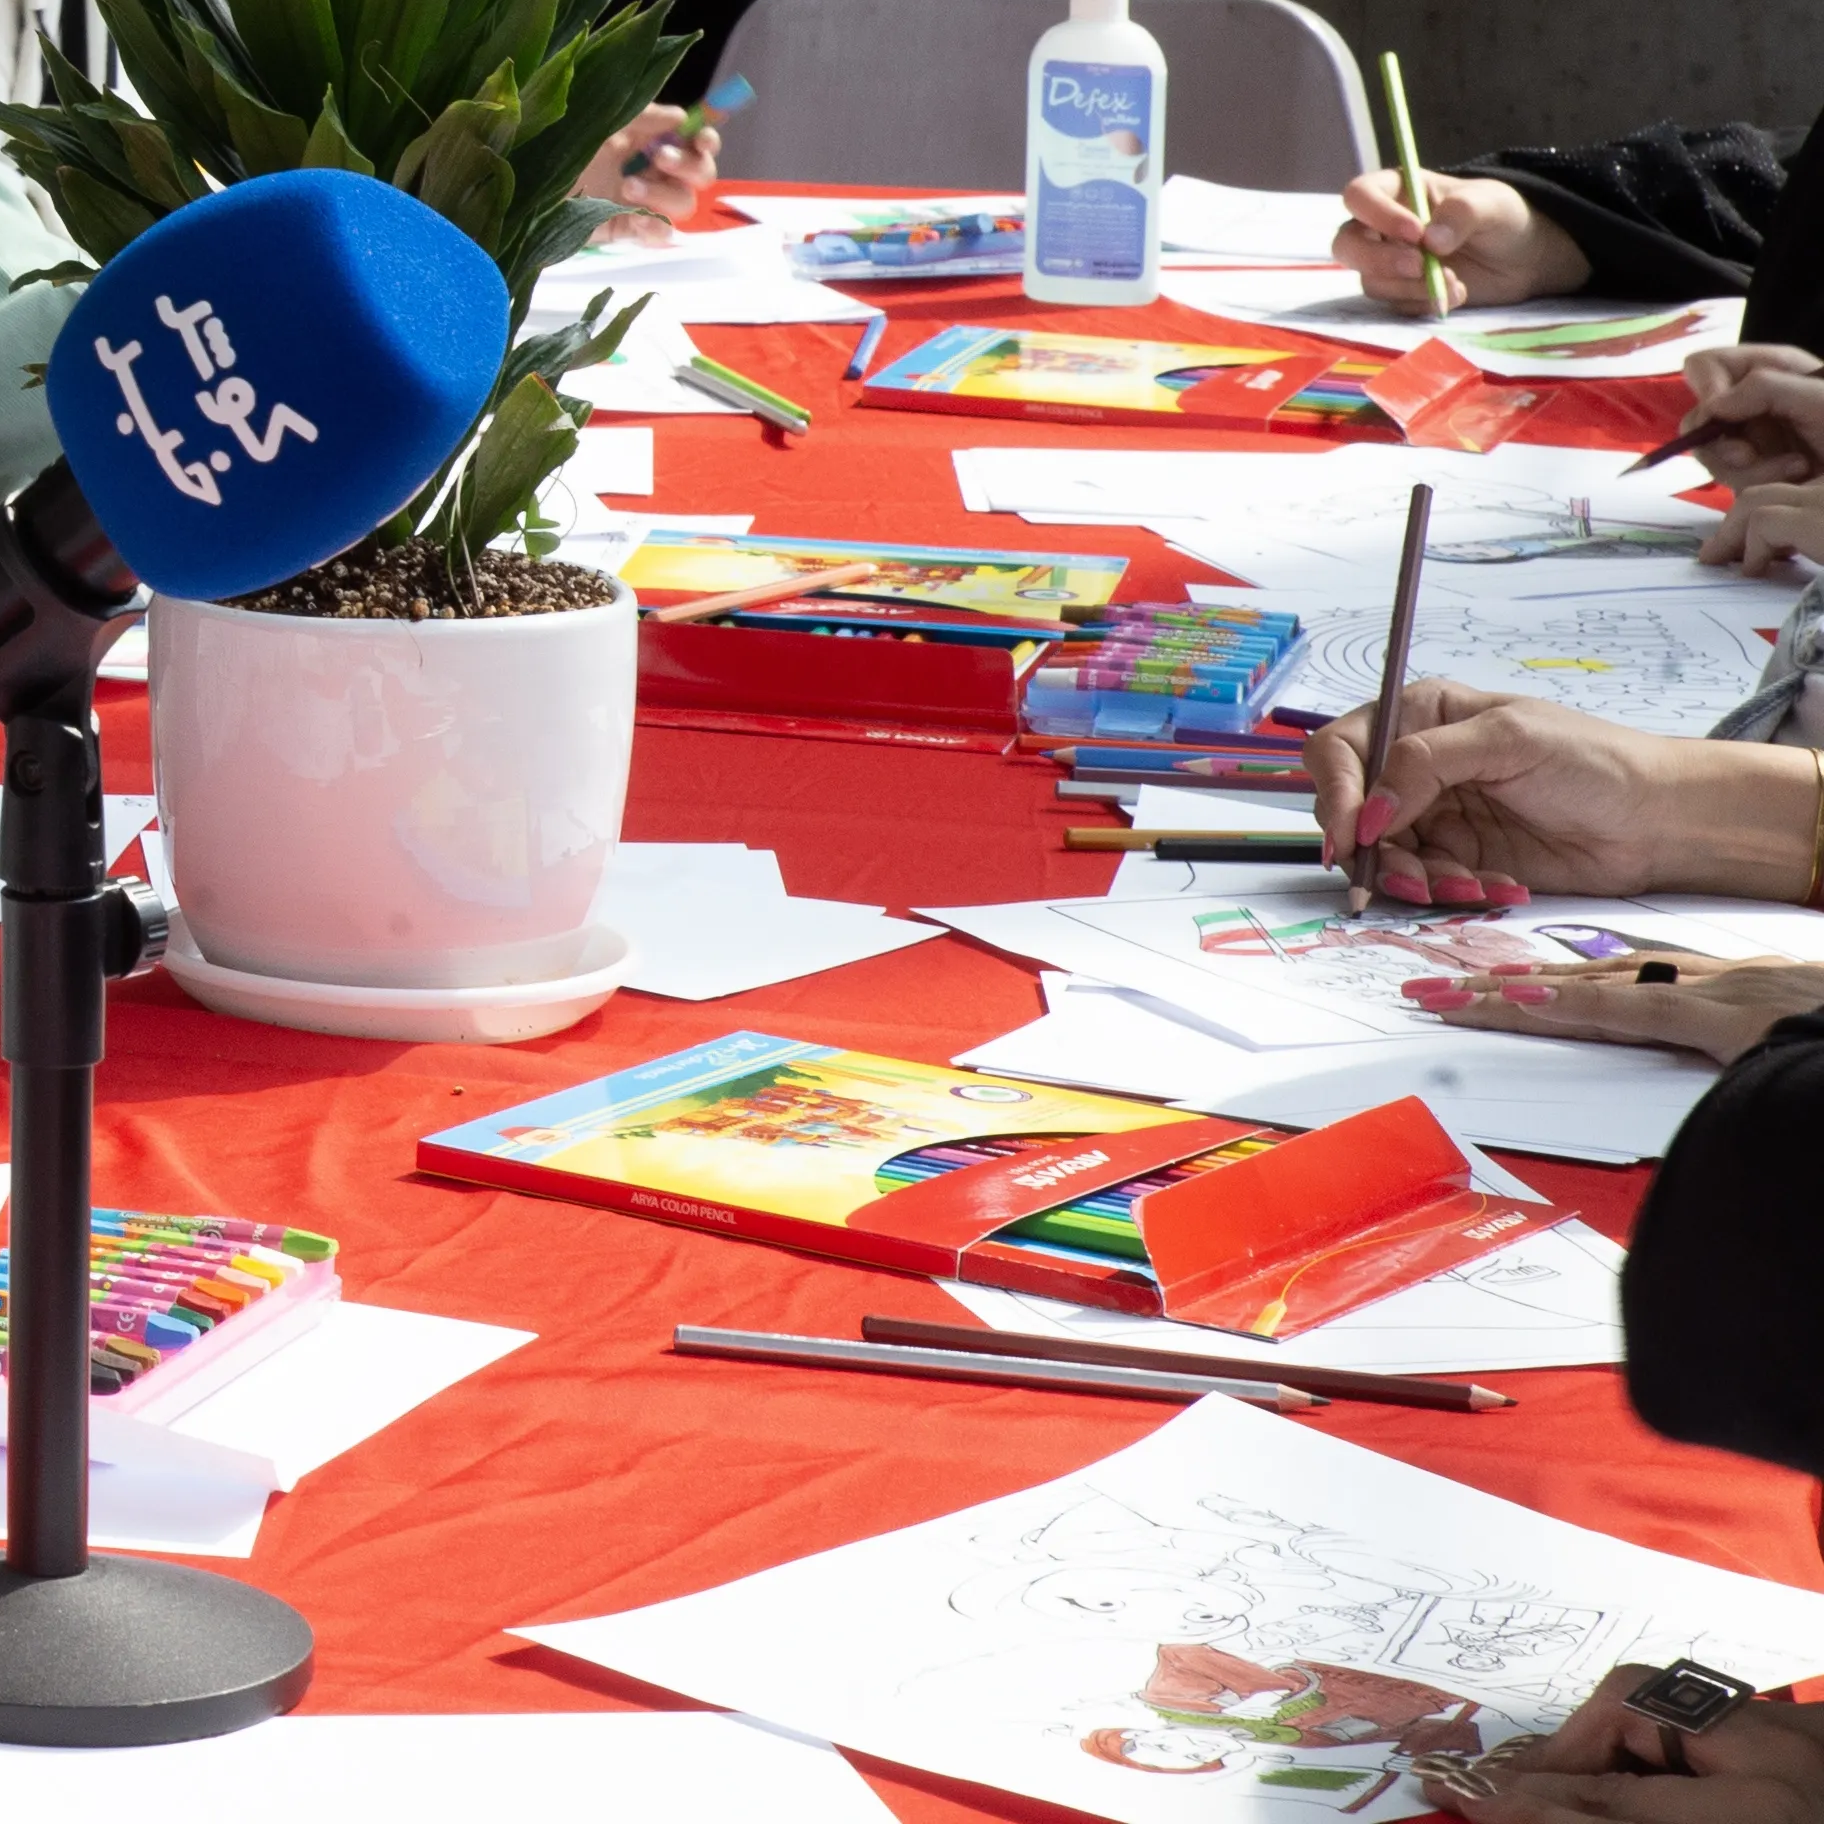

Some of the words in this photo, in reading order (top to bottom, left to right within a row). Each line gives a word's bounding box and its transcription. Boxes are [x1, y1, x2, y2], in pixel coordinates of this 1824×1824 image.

[94, 336, 231, 506] خبر
[631, 1192, 658, 1208] ARYA
[661, 1198, 699, 1217] COLOR
[700, 1205, 737, 1225] PENCIL
[118, 1211, 167, 1223] Stationery
[170, 1216, 202, 1228] Quality
[204, 1218, 226, 1228] Best
